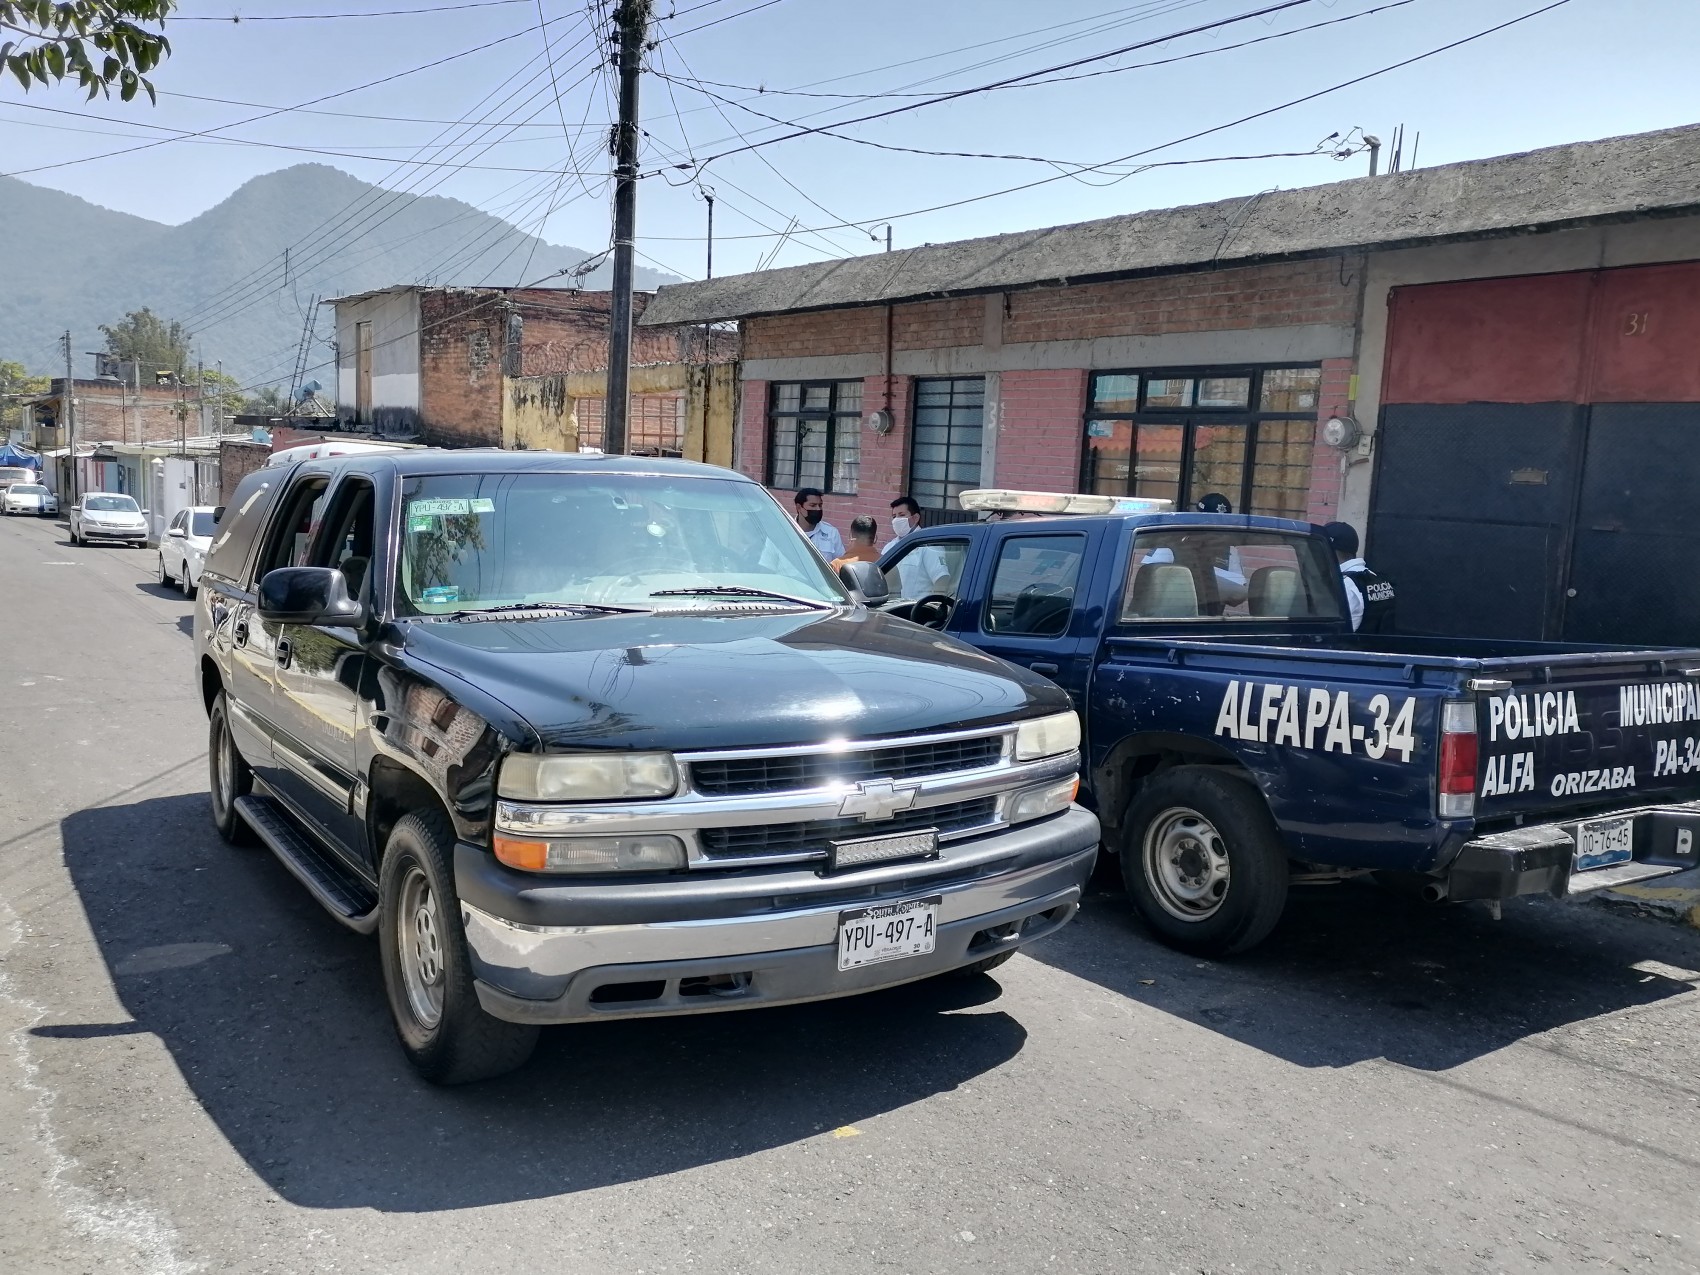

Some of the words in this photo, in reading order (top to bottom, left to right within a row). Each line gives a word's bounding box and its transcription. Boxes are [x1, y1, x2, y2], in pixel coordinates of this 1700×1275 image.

[1625, 312, 1648, 336] 31
[1489, 690, 1581, 742] POLICIA
[1482, 751, 1536, 798] ALFA
[1550, 765, 1636, 797] ORIZABA
[1583, 828, 1629, 853] 00-76-45
[845, 913, 933, 952] YPU-497-A
